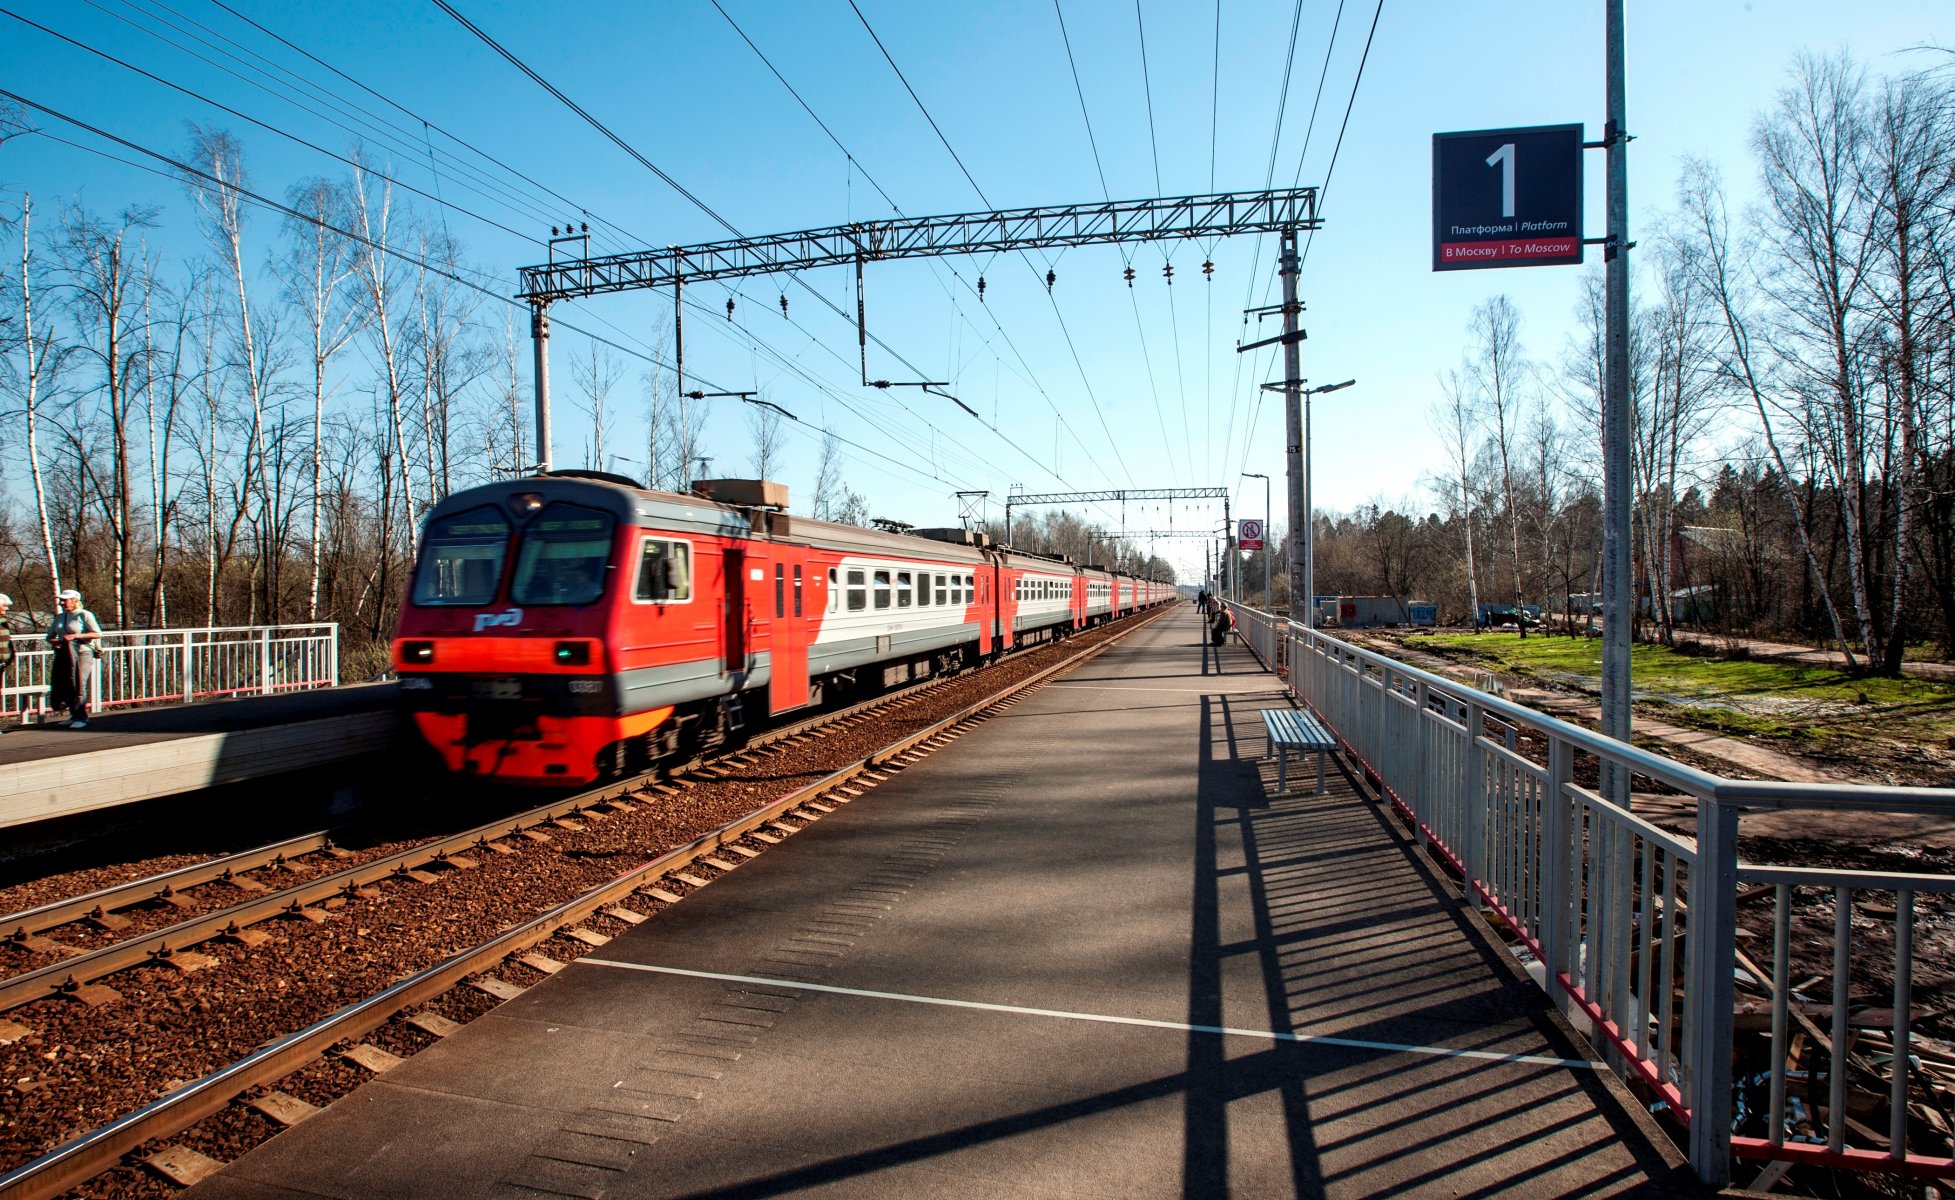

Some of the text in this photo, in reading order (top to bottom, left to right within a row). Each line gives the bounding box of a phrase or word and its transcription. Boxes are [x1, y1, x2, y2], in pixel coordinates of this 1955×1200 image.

[1485, 143, 1515, 217] 1
[1451, 224, 1513, 236] Платформа
[1521, 220, 1567, 231] Platform
[1446, 246, 1497, 258] В Москву
[1509, 243, 1570, 254] To Moscow
